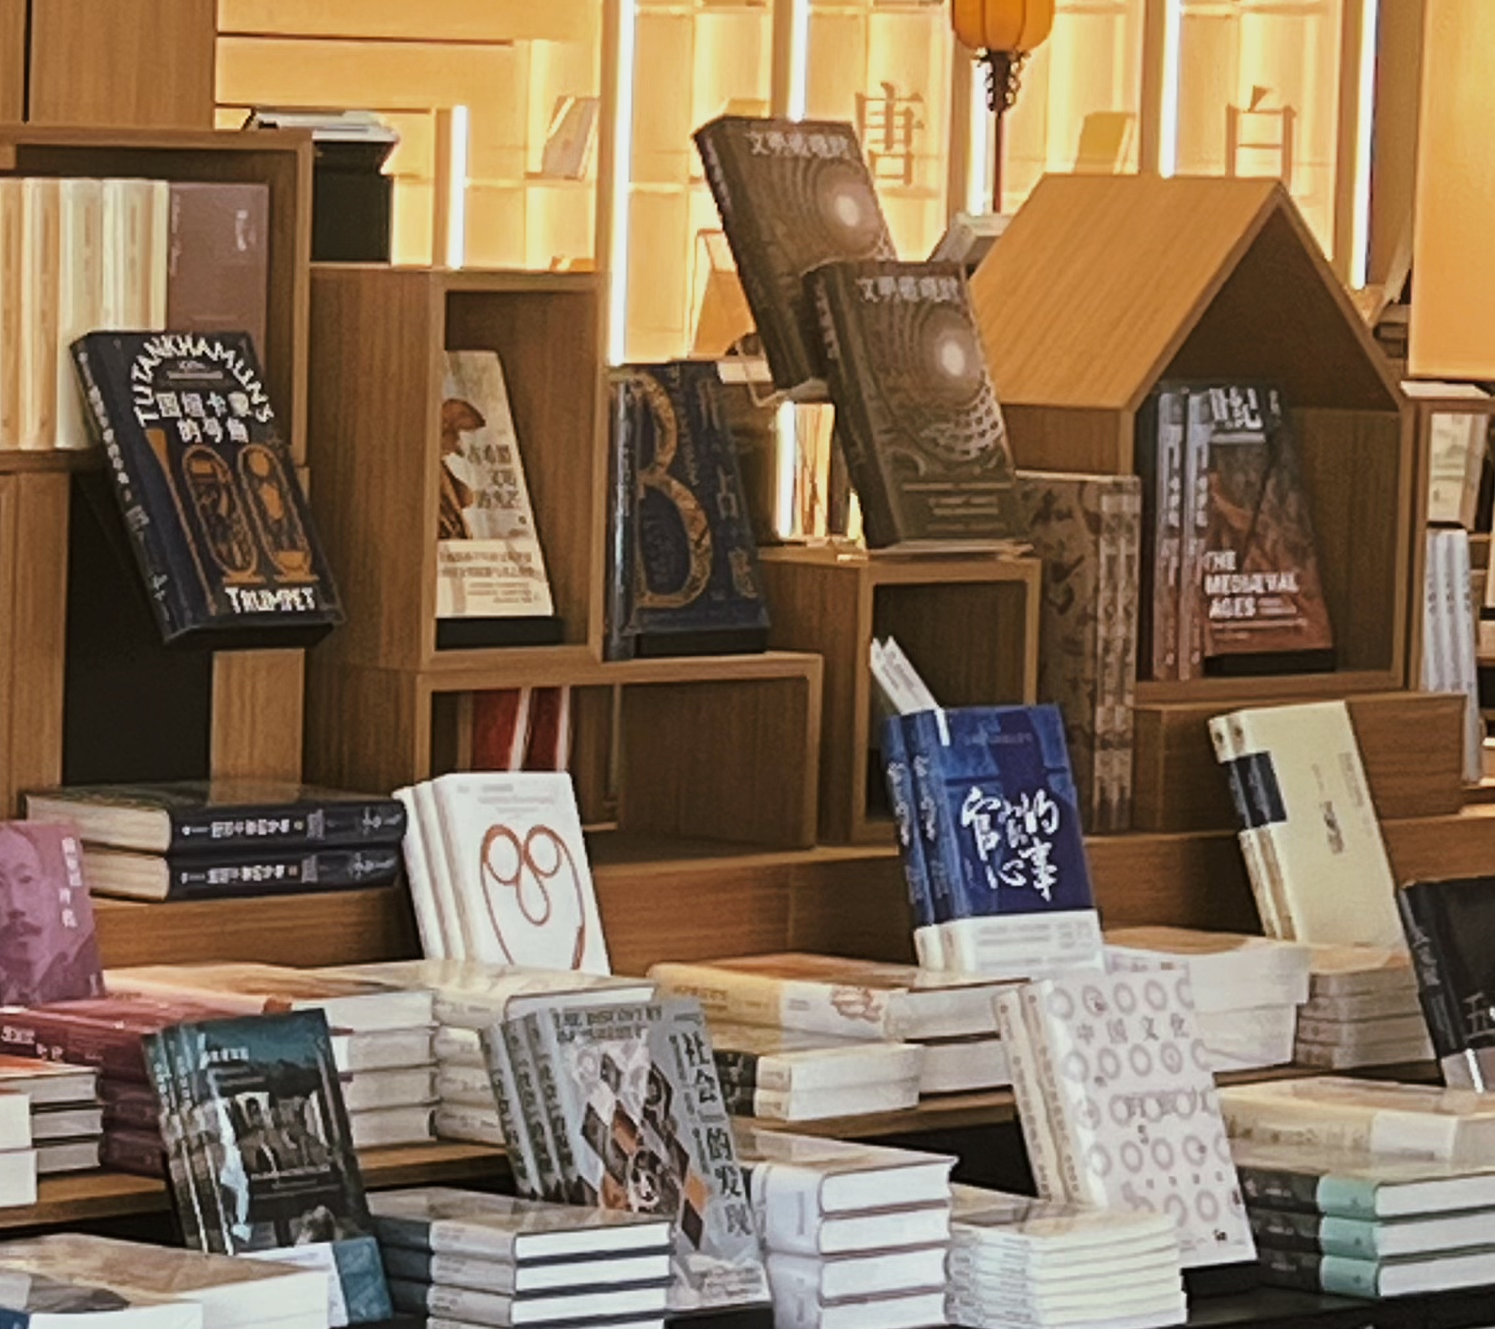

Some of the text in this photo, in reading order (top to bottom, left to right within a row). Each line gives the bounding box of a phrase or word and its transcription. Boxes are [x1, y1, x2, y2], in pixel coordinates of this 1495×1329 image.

[855, 82, 925, 187] 唐
[224, 586, 316, 614] TRUMPET
[1208, 597, 1256, 619] AGES
